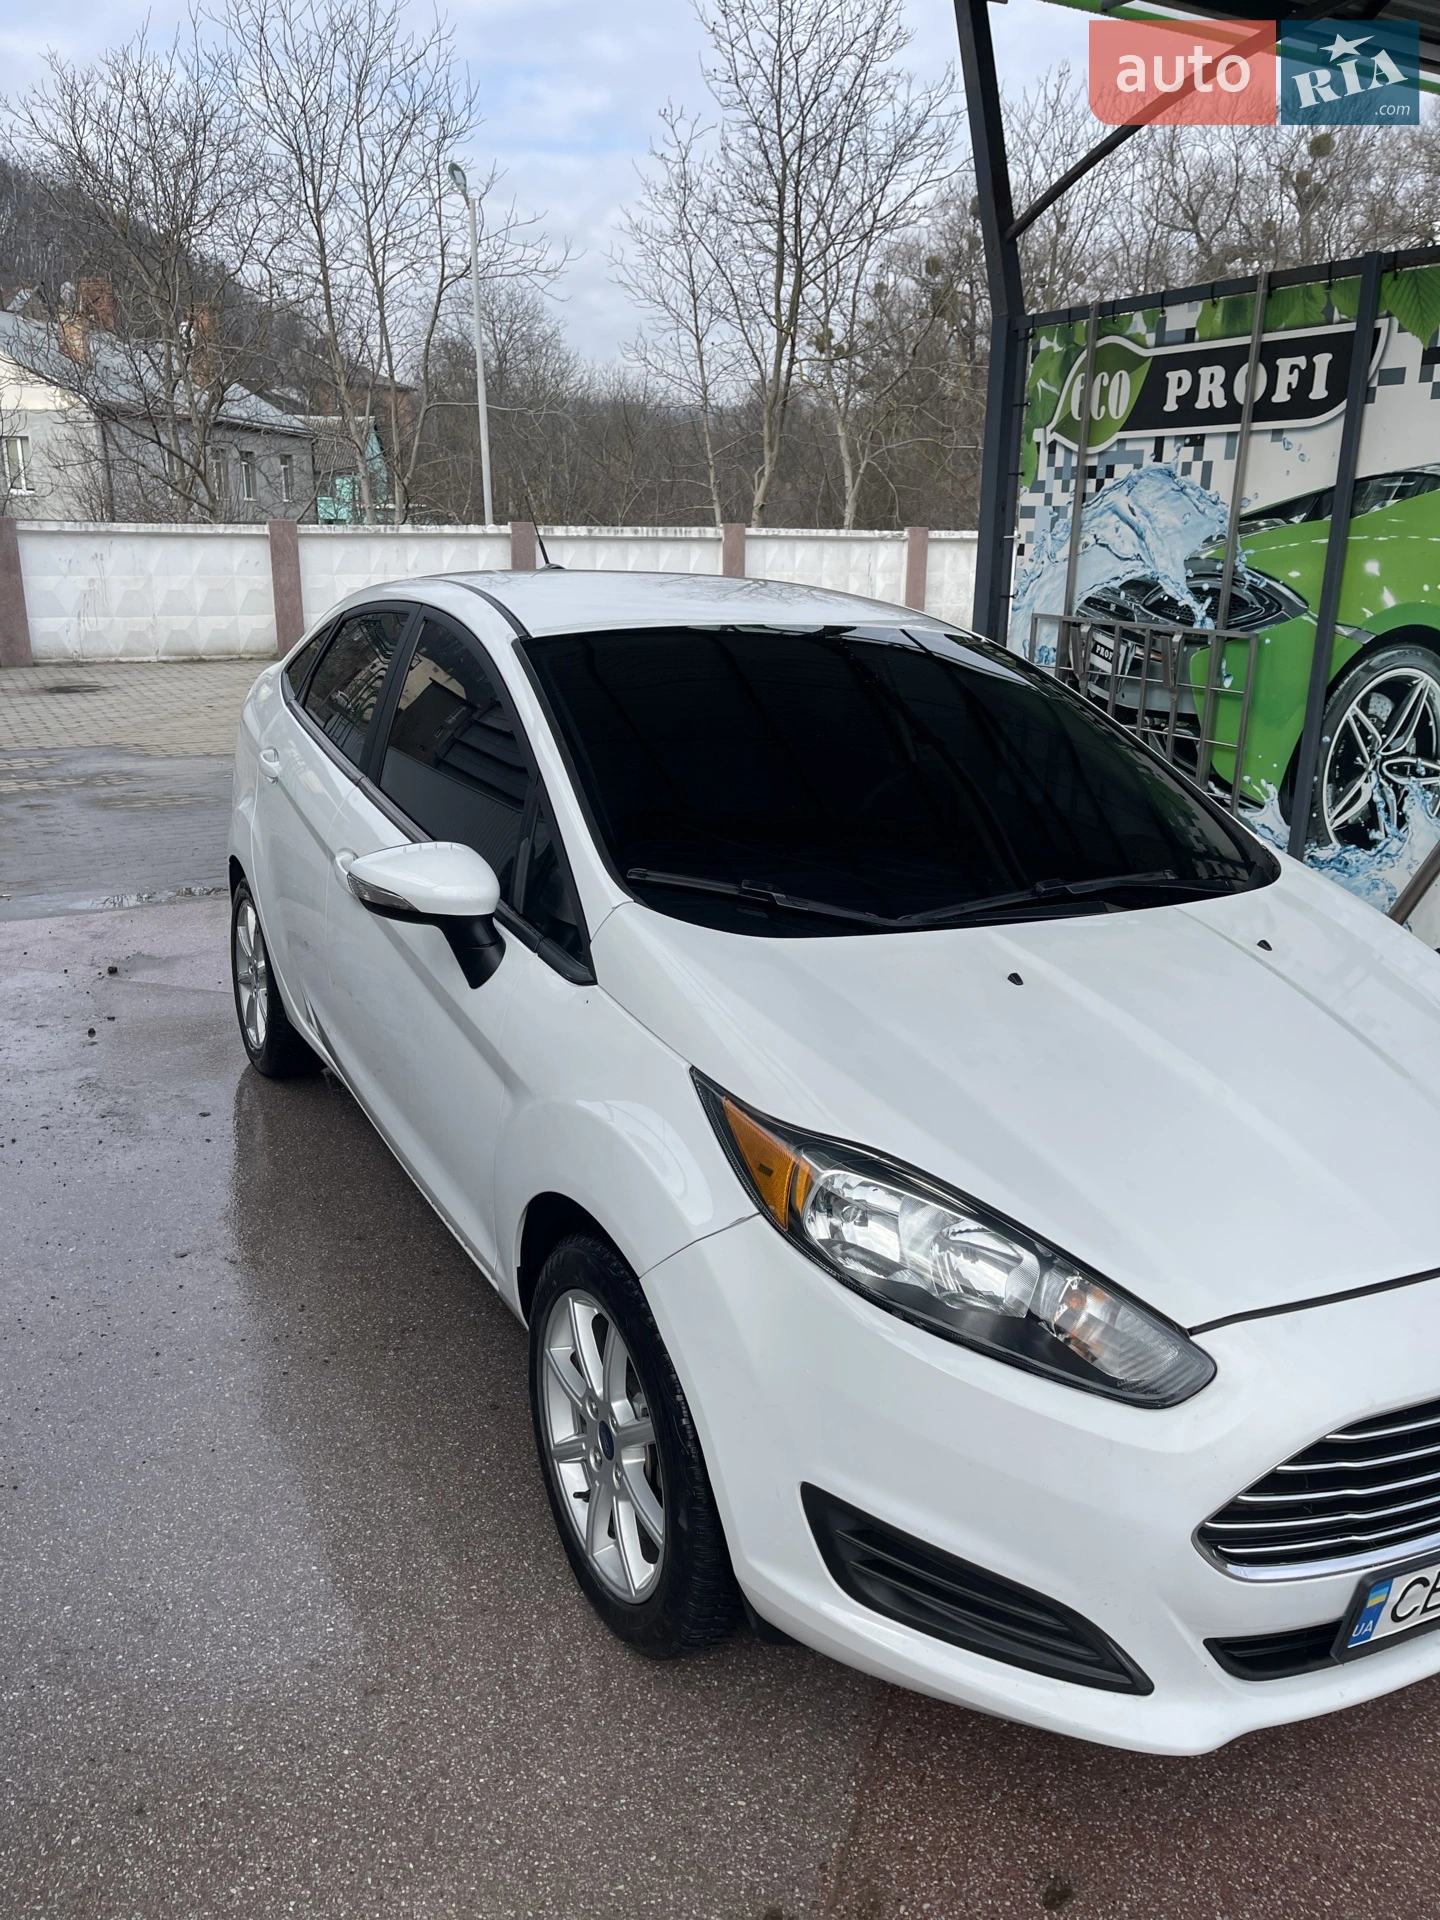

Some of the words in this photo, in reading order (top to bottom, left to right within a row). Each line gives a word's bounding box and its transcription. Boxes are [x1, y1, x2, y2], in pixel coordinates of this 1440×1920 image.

[1162, 352, 1334, 412] PROFI
[1095, 644, 1114, 661] PROF
[1352, 1619, 1374, 1637] UA
